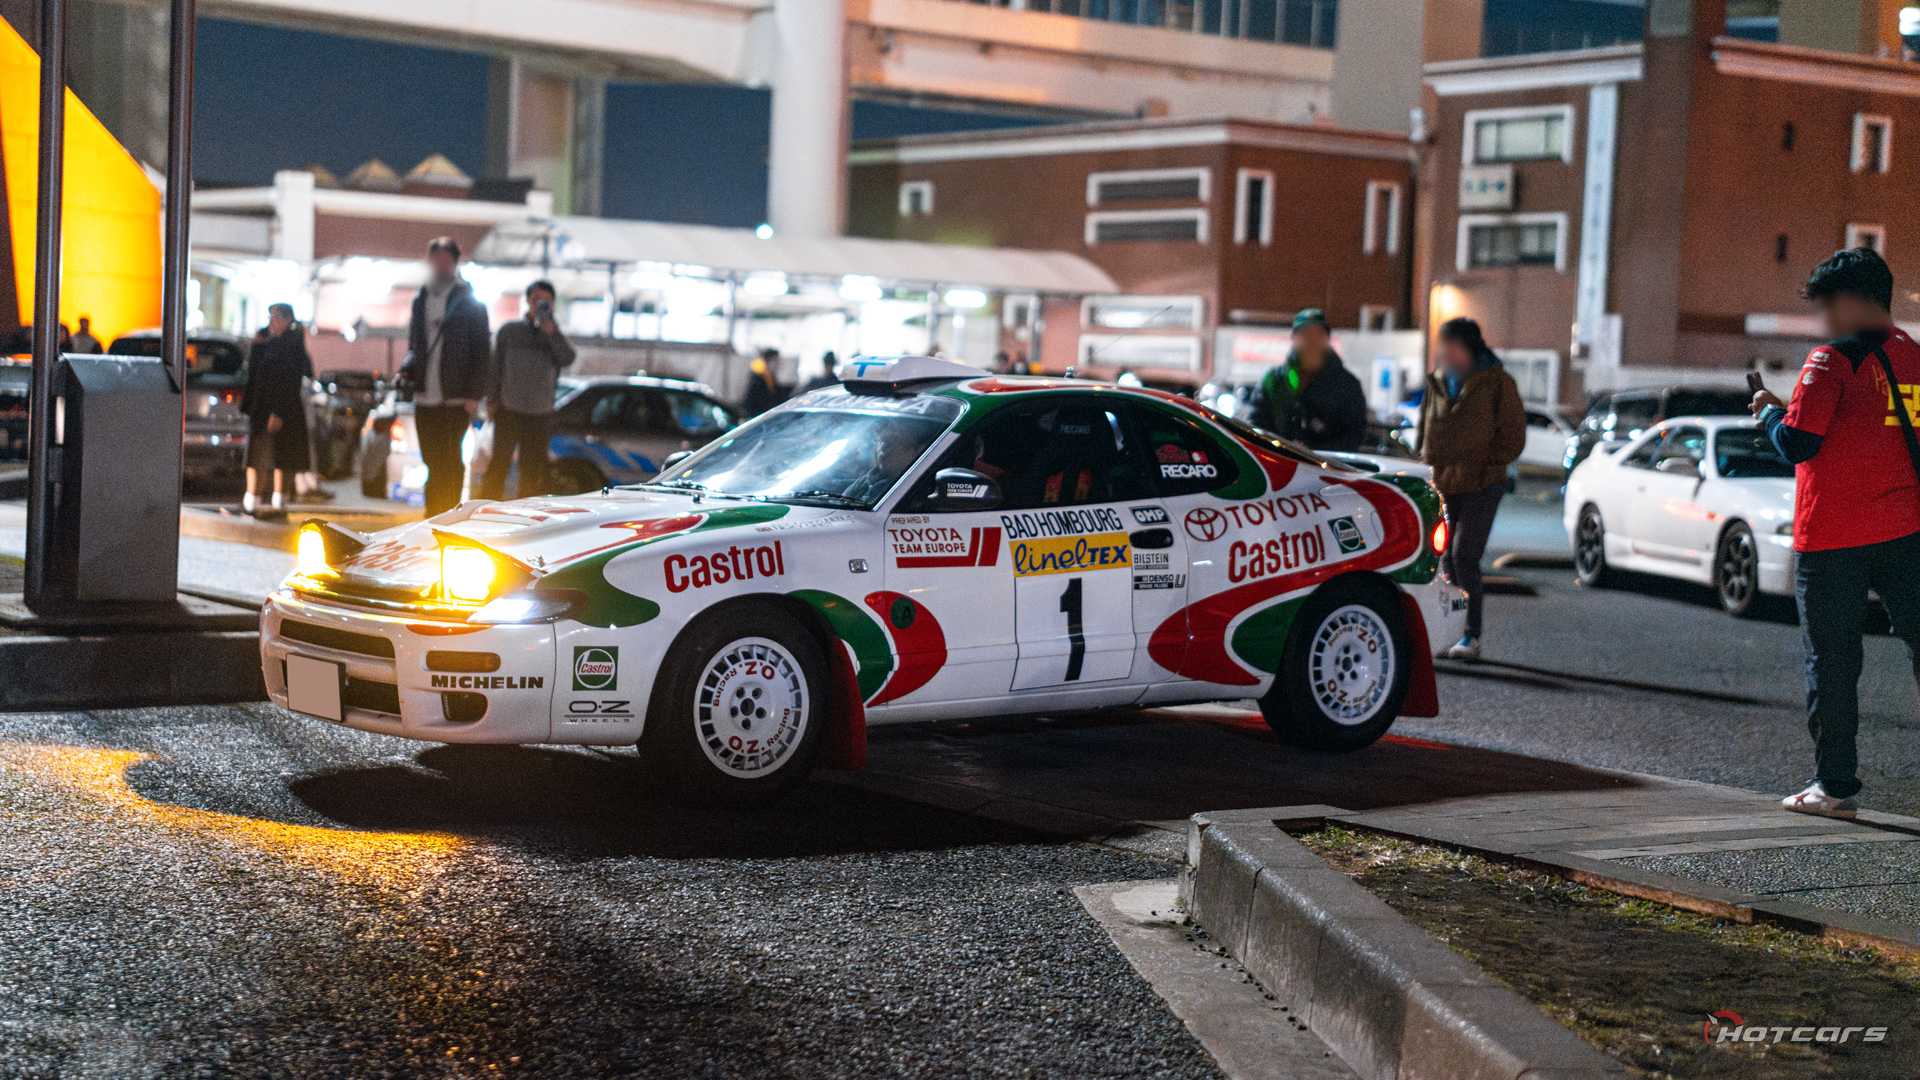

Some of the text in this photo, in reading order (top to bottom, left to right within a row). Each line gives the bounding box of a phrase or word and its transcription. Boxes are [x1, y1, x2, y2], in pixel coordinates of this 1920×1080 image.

[1160, 465, 1217, 478] RECARO
[1134, 508, 1164, 522] OMP
[1224, 493, 1330, 528] TOYOTA
[1000, 507, 1124, 539] BAD HOMBOURG
[888, 528, 962, 542] TOYOTA
[892, 543, 966, 554] TEAM EUROPE
[1134, 553, 1169, 564] BILSTEIN
[1228, 524, 1326, 583] Castrol
[664, 540, 785, 593] Castrol
[1060, 577, 1085, 682] 1
[431, 675, 544, 689] MICHELIN
[767, 708, 790, 747] Racing
